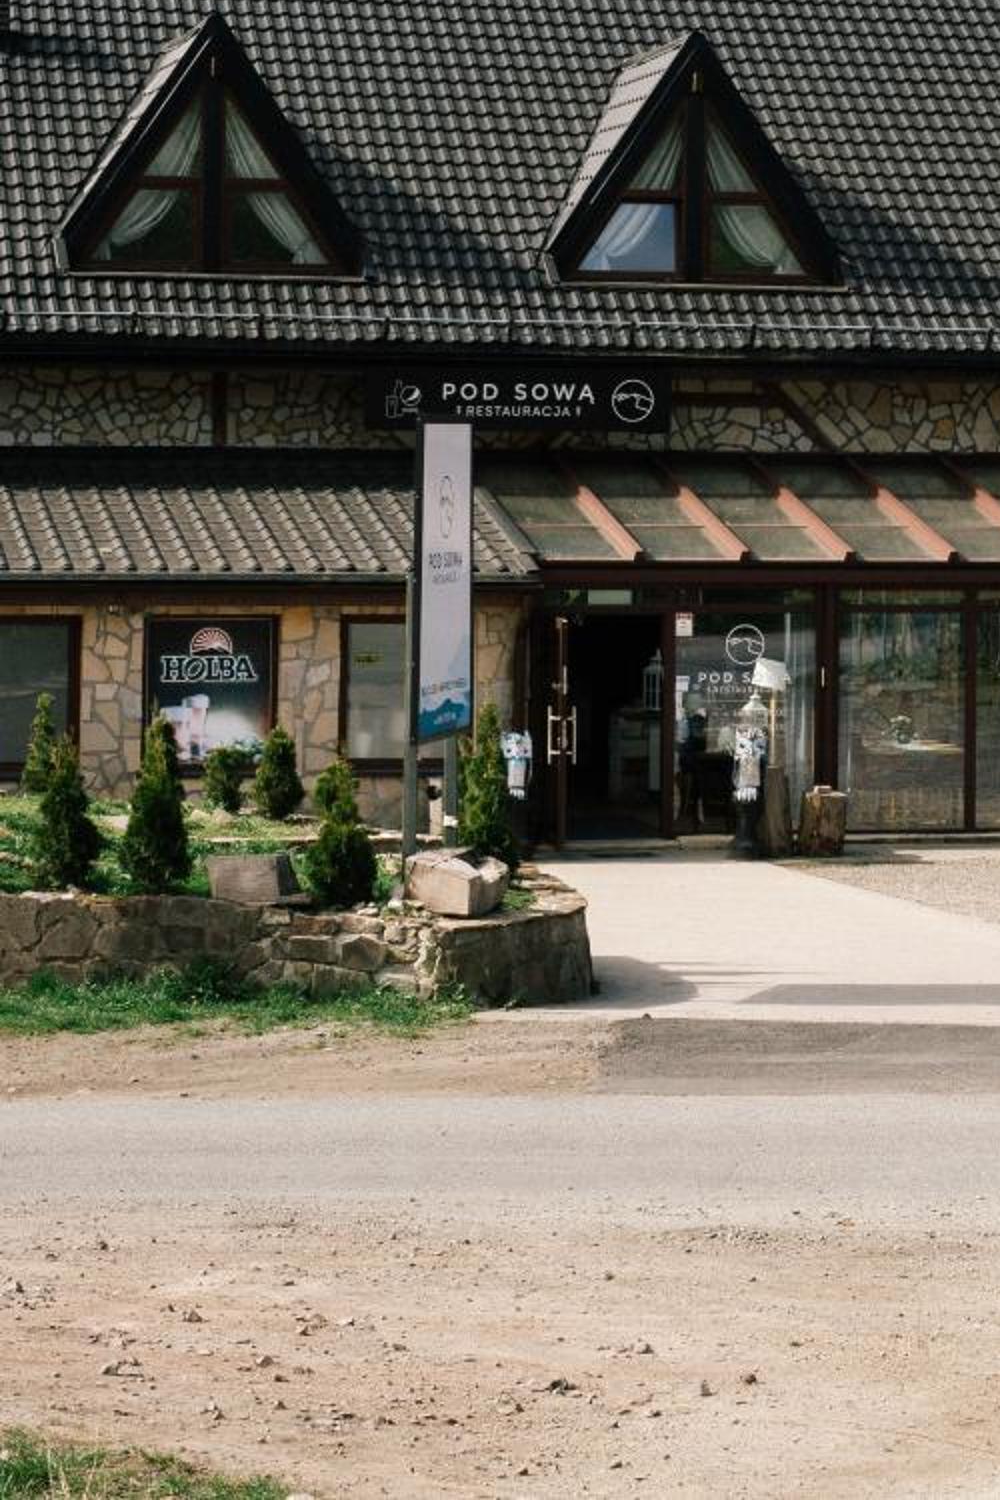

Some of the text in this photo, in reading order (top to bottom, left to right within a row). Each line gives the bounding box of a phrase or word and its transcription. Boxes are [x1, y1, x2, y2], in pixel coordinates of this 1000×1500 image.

[442, 383, 595, 405] POD SOWĄ
[465, 405, 571, 418] RESTAURACJA
[160, 655, 258, 683] HOLBA
[697, 671, 733, 684] POD
